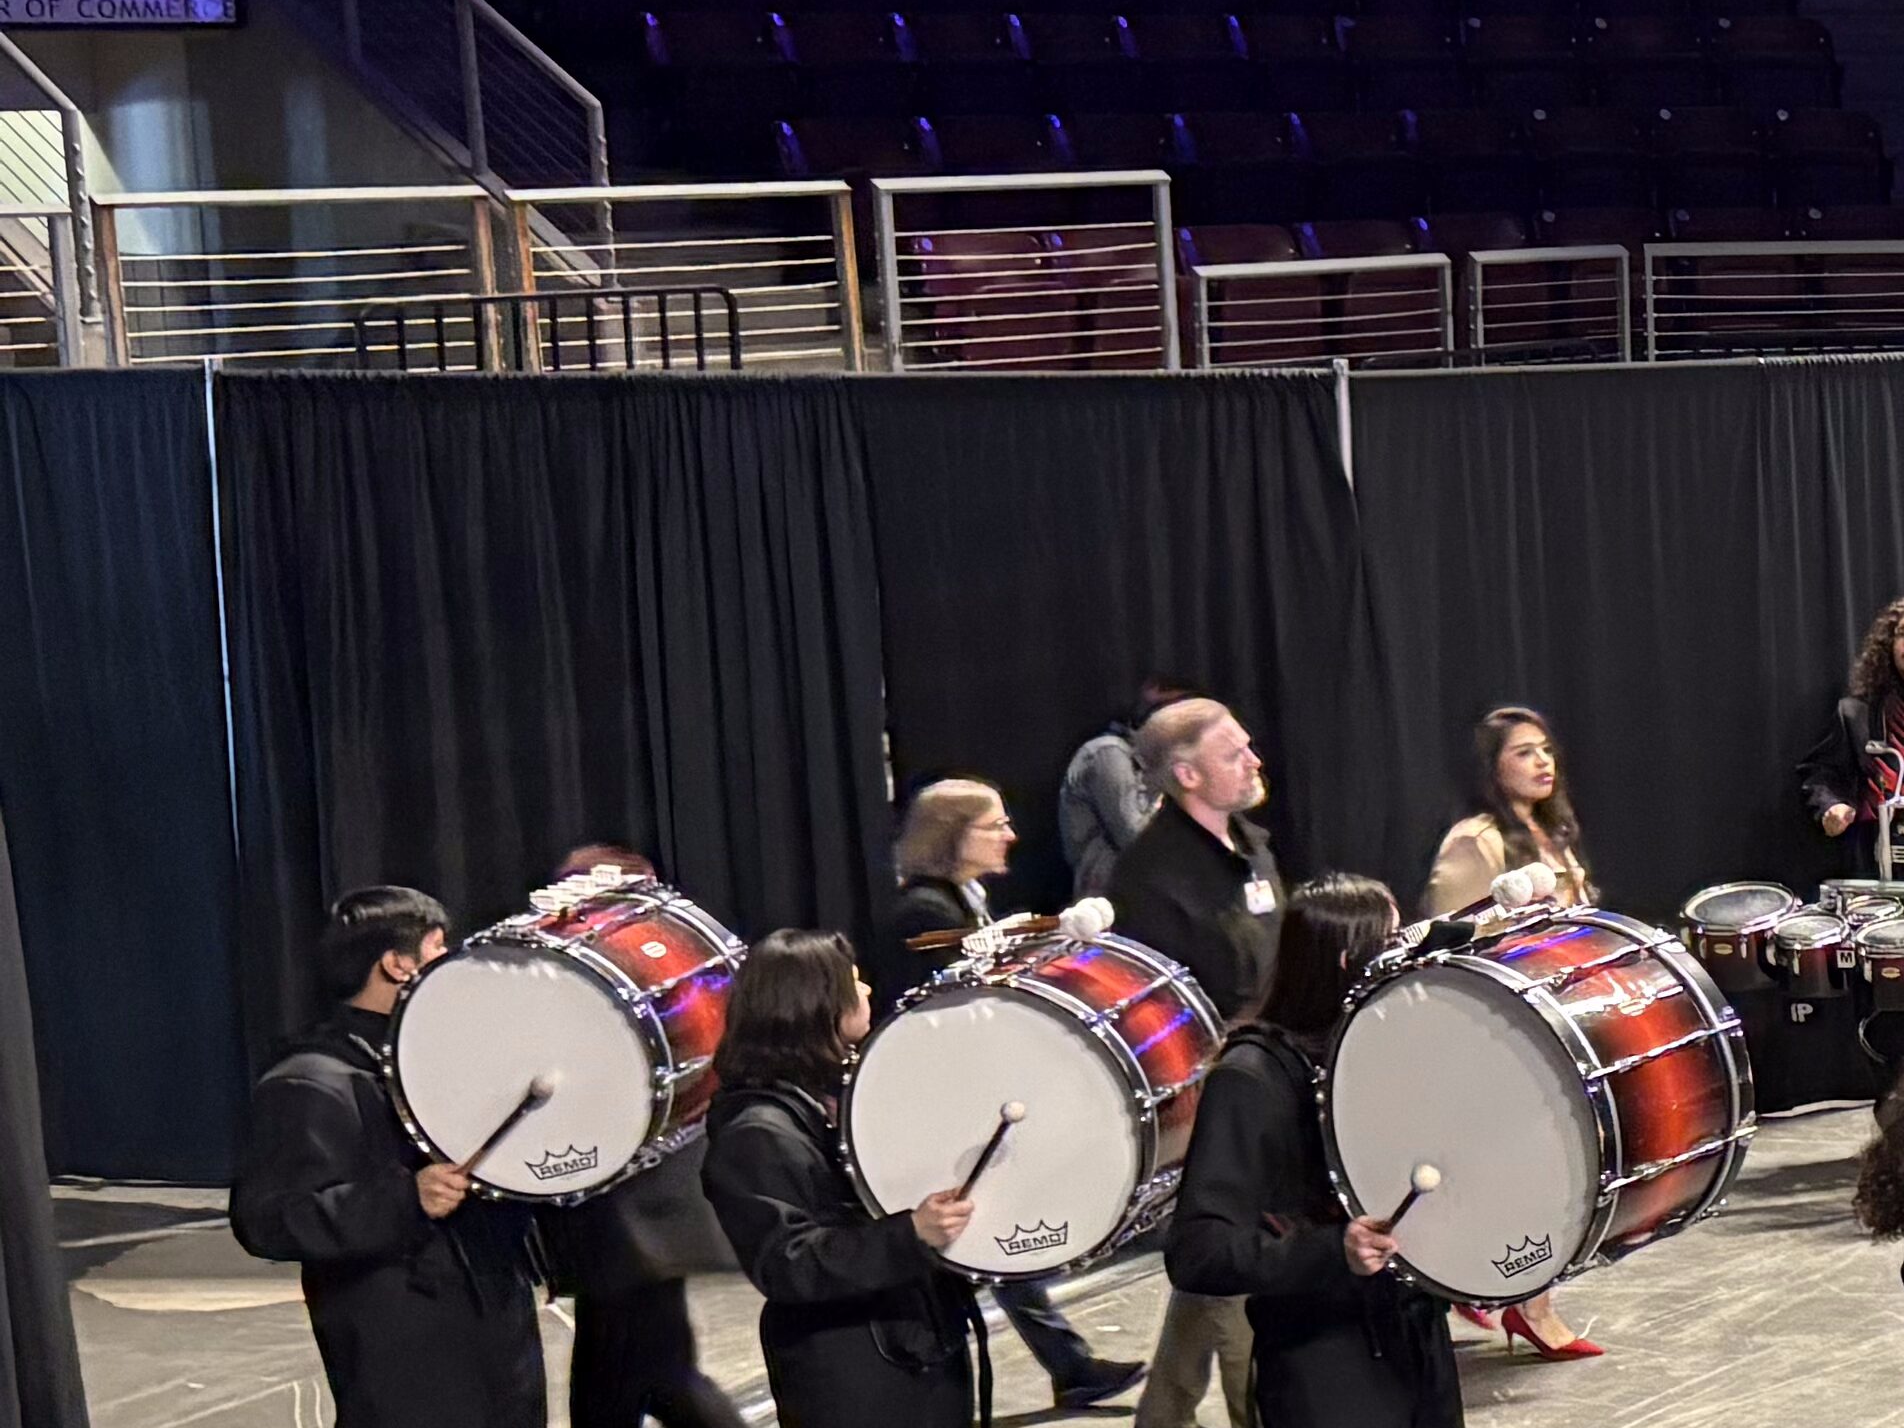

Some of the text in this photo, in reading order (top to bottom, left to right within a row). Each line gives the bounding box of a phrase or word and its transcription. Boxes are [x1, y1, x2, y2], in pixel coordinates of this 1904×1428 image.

[1838, 950, 1855, 967] M
[539, 1156, 592, 1176] REMO
[1008, 1232, 1062, 1251] REMO
[1504, 1246, 1547, 1274] REMO
